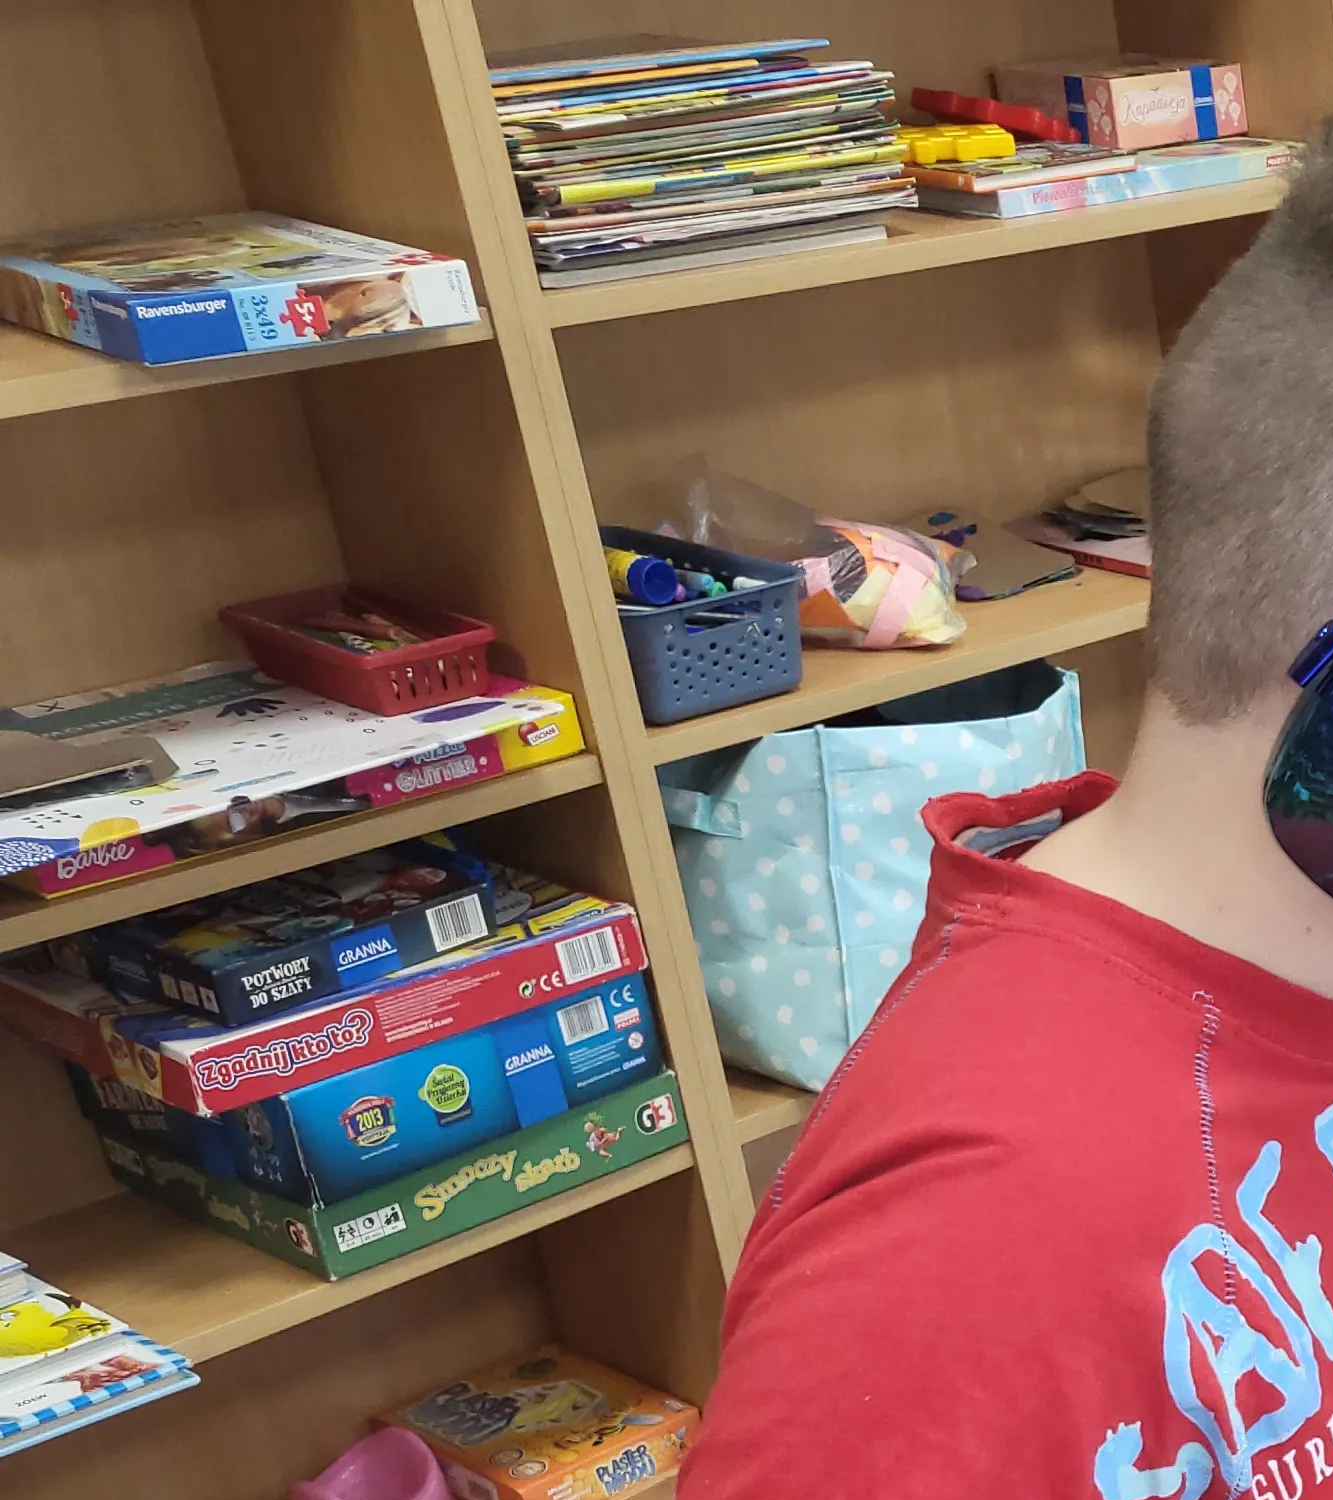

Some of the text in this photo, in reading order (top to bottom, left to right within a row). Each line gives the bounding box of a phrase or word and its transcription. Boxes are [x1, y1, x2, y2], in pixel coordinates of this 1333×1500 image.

[136, 297, 227, 320] Ravensburger
[251, 294, 279, 341] 3x49
[295, 302, 315, 324] 5+
[57, 838, 134, 880] Barbie
[338, 937, 392, 966] GRANNA
[241, 956, 310, 992] POTWORY
[249, 976, 313, 1009] DO SZAFY
[199, 1012, 369, 1086] Zgadnij kto to?
[504, 1043, 554, 1071] GRANNA
[356, 1107, 384, 1132] 2013
[414, 1147, 582, 1222] Smoczy skarb
[596, 1444, 650, 1485] PLASTER
